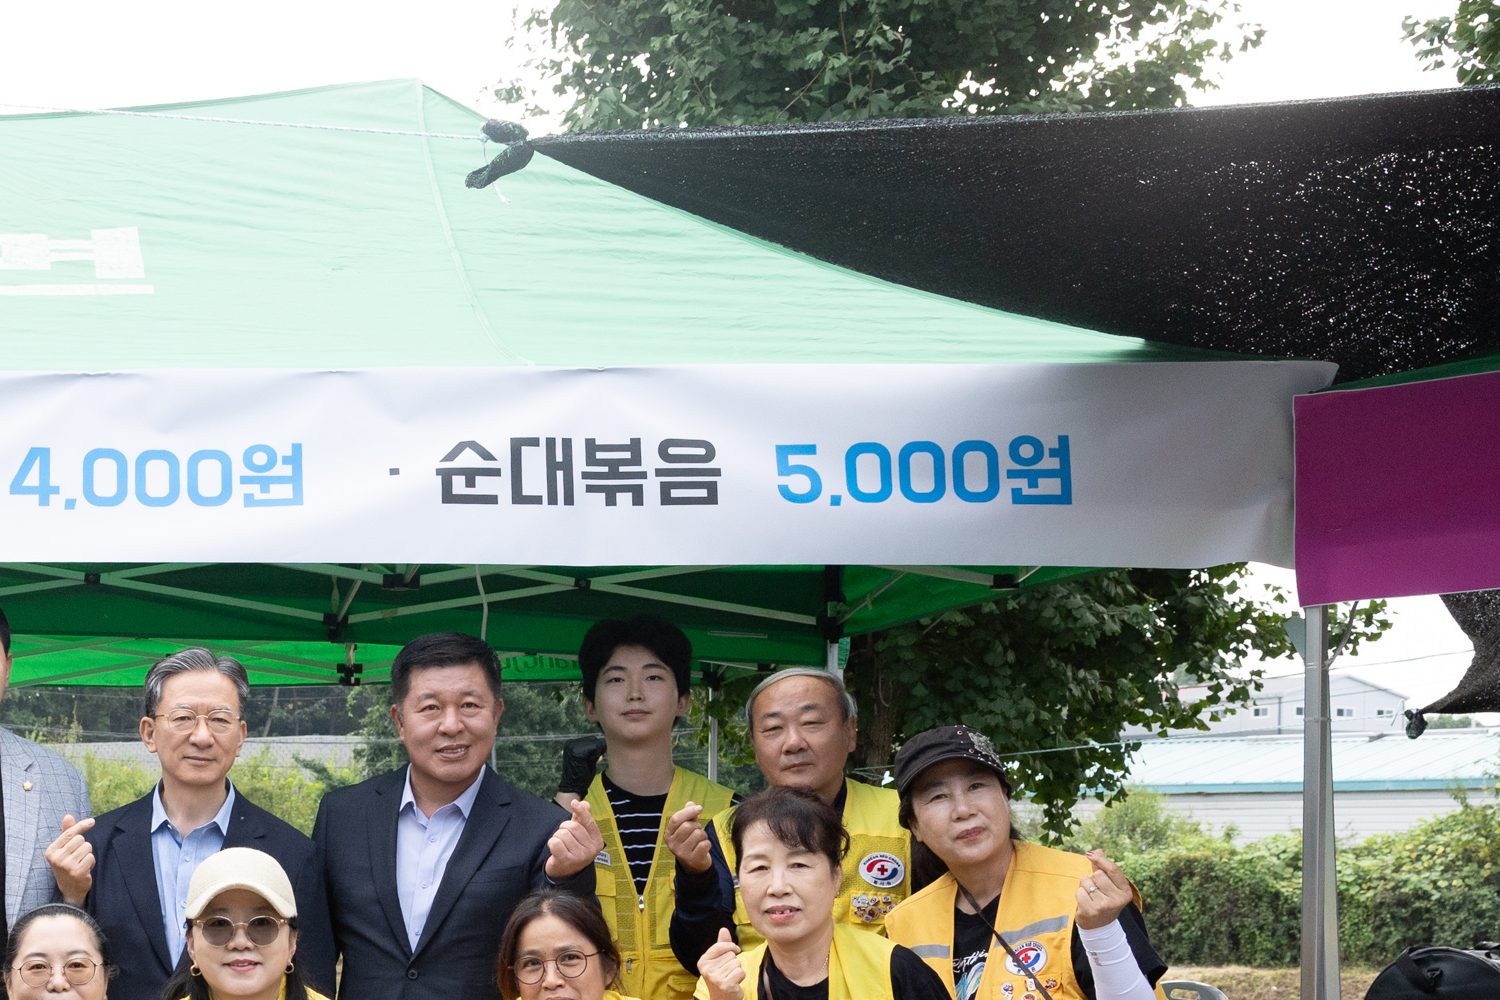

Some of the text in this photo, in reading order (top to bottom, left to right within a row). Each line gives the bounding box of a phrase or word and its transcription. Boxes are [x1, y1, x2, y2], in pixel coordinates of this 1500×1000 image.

[8, 443, 305, 511] 4,000원
[435, 435, 723, 507] 순대볶음
[775, 433, 1073, 507] 5,000원
